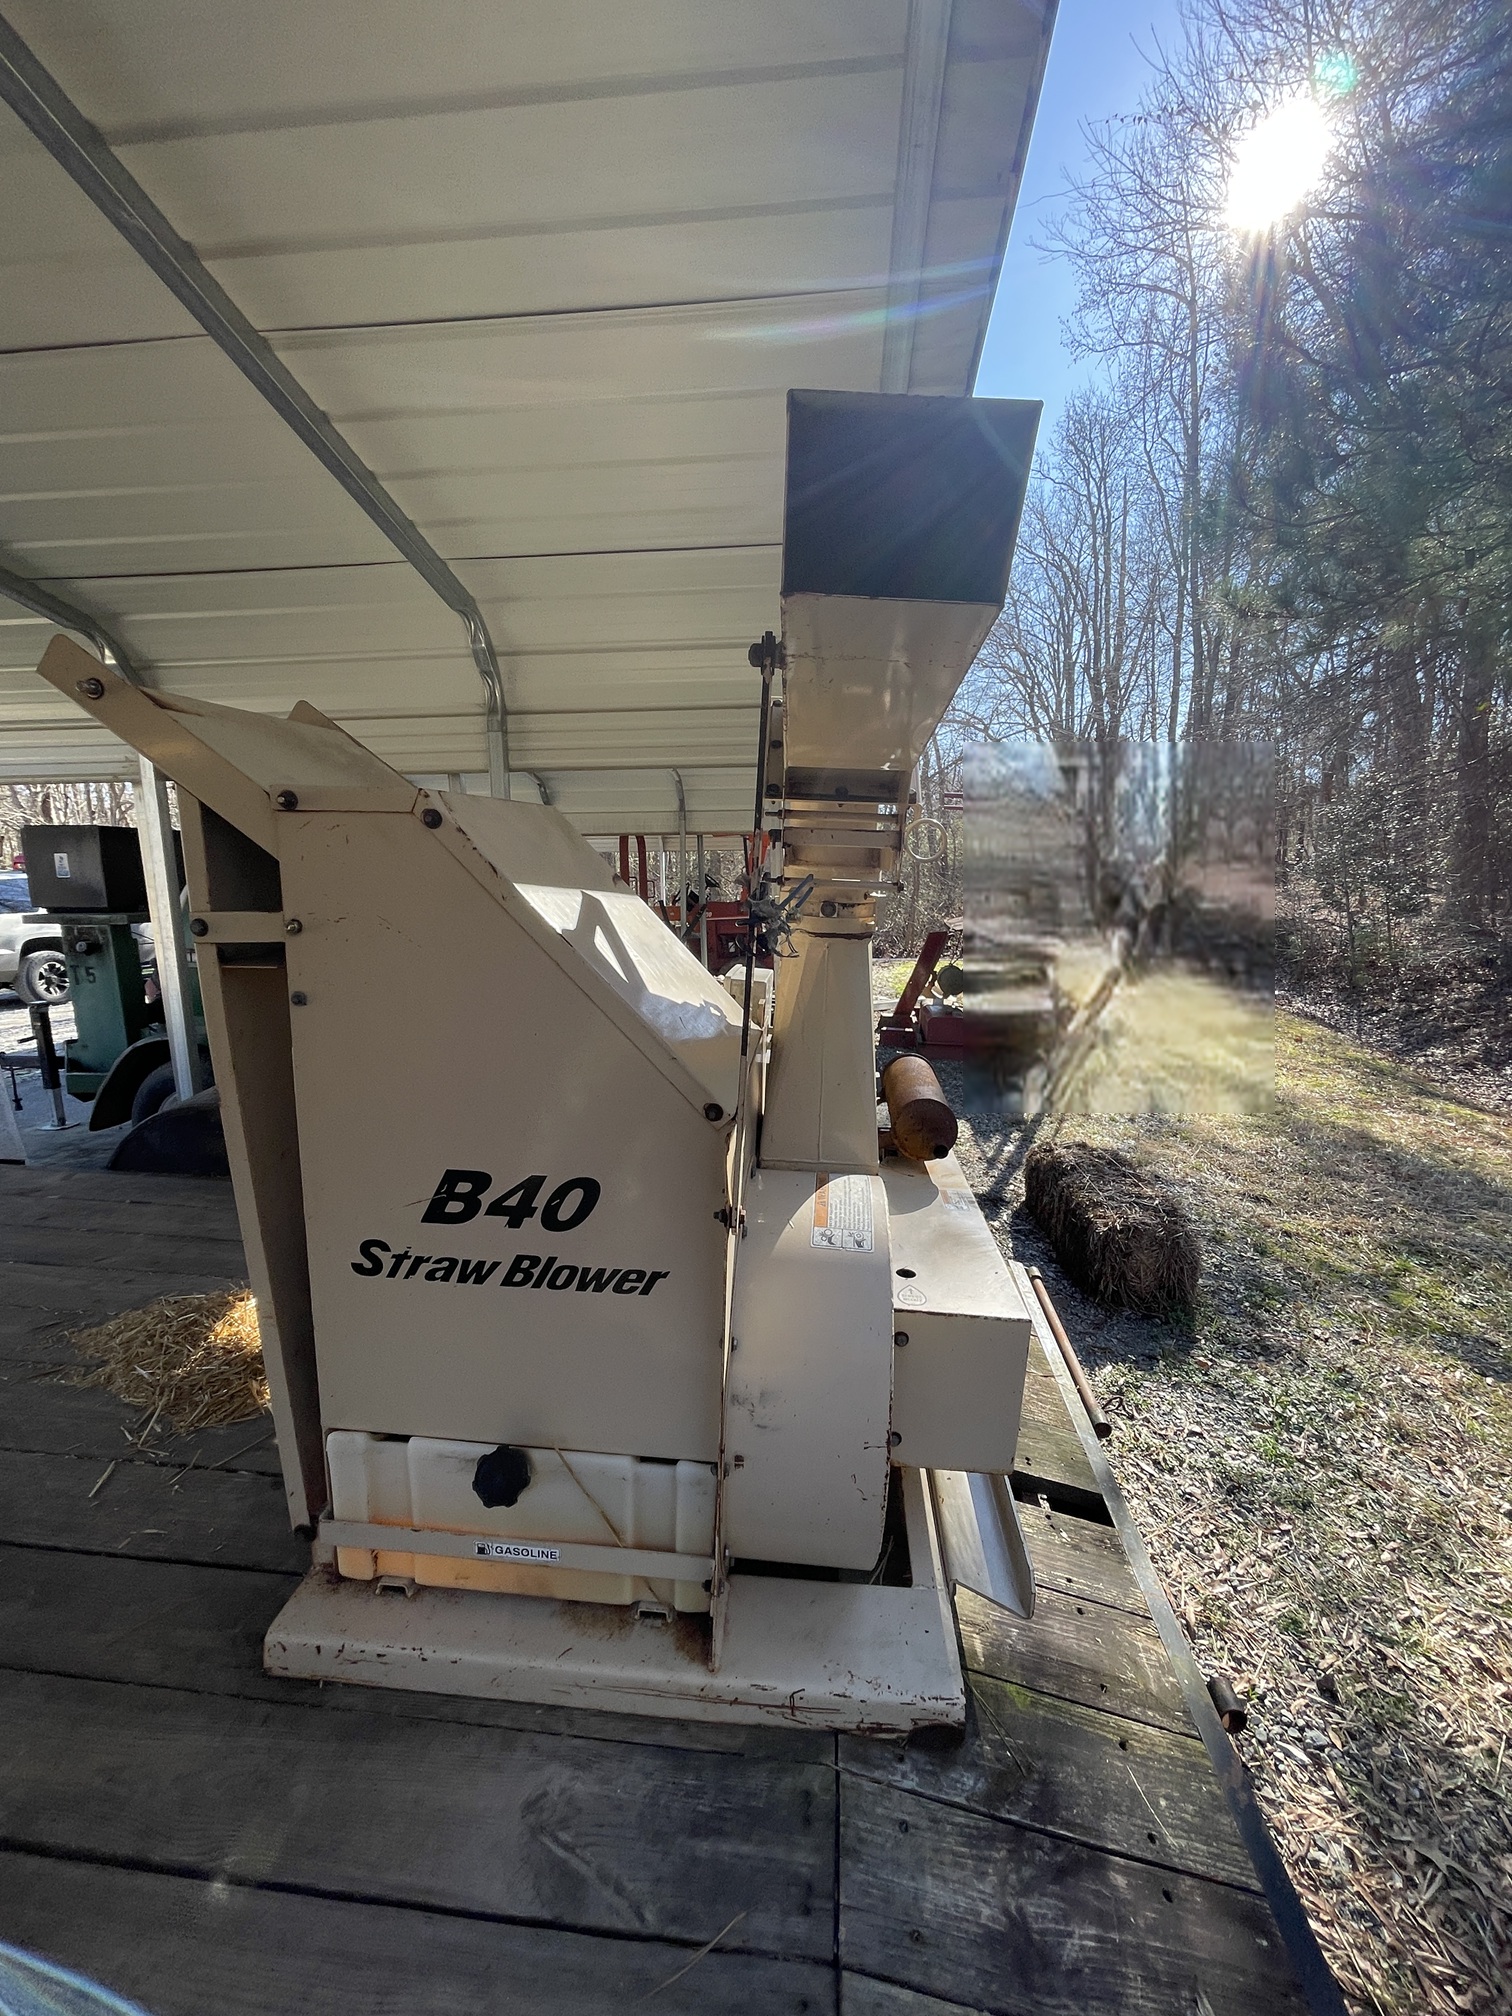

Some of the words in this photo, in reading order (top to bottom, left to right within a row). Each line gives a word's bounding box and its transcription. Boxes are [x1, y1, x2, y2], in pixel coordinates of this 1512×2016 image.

[420, 1168, 601, 1233] B40
[350, 1238, 502, 1287] Straw
[499, 1253, 671, 1297] Blower
[494, 1545, 558, 1560] GASOLINE
